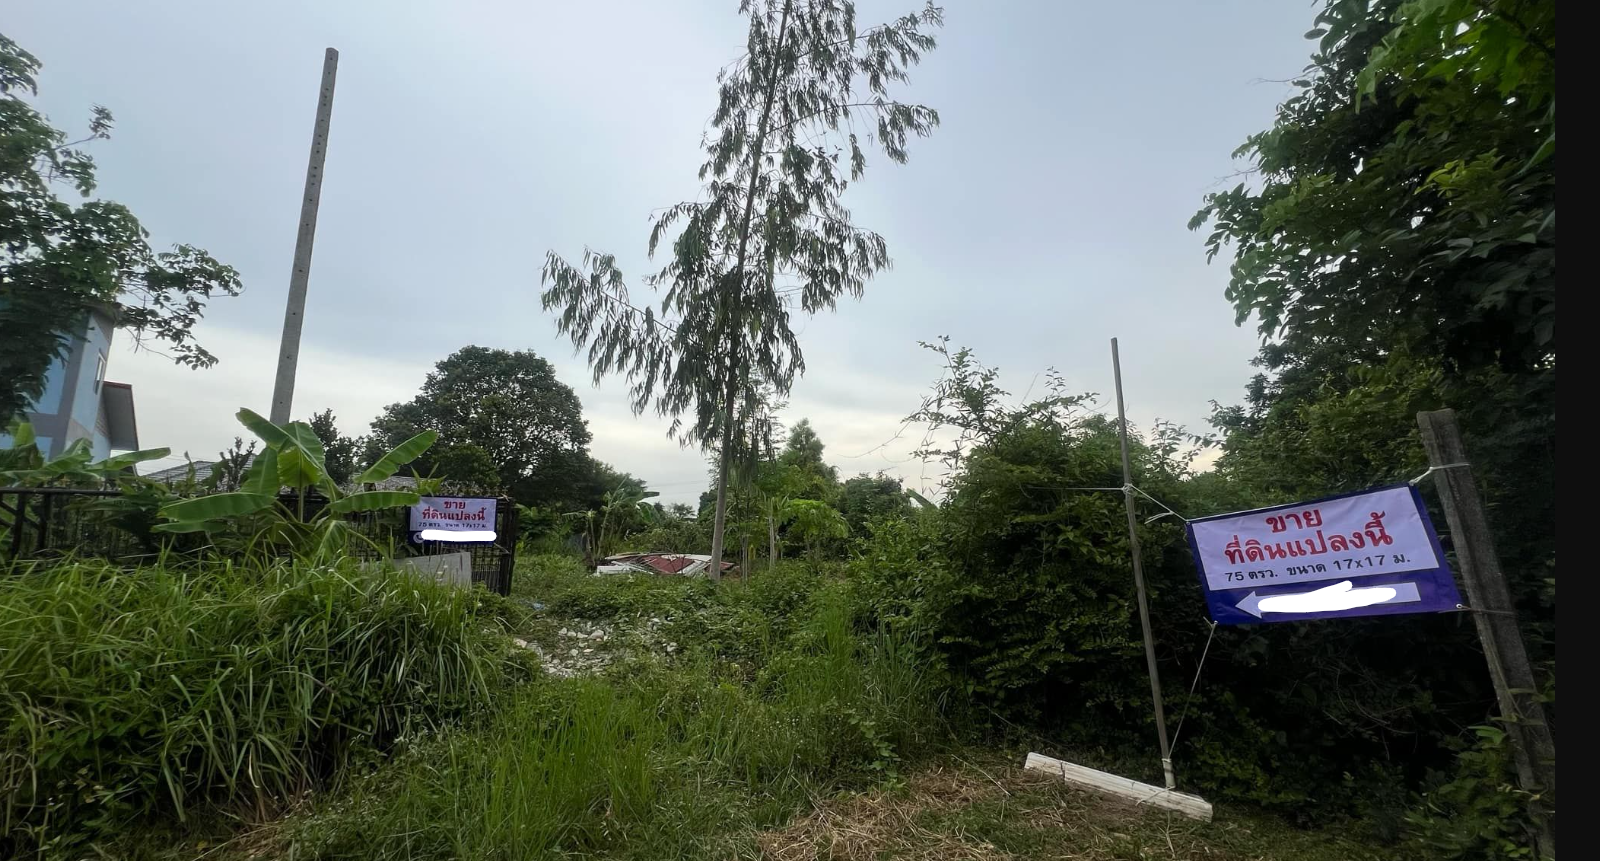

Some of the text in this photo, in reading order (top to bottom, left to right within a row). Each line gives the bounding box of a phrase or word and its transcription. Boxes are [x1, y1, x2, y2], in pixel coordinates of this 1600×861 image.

[422, 505, 487, 521] ที่ดินแปลงนี้
[444, 500, 466, 509] ขาย
[1265, 508, 1323, 534] ขาย
[1224, 511, 1394, 566] ที่ดินแปลงนี้
[1225, 553, 1411, 582] 75 ตรว. ขนาด 17x17 ม.
